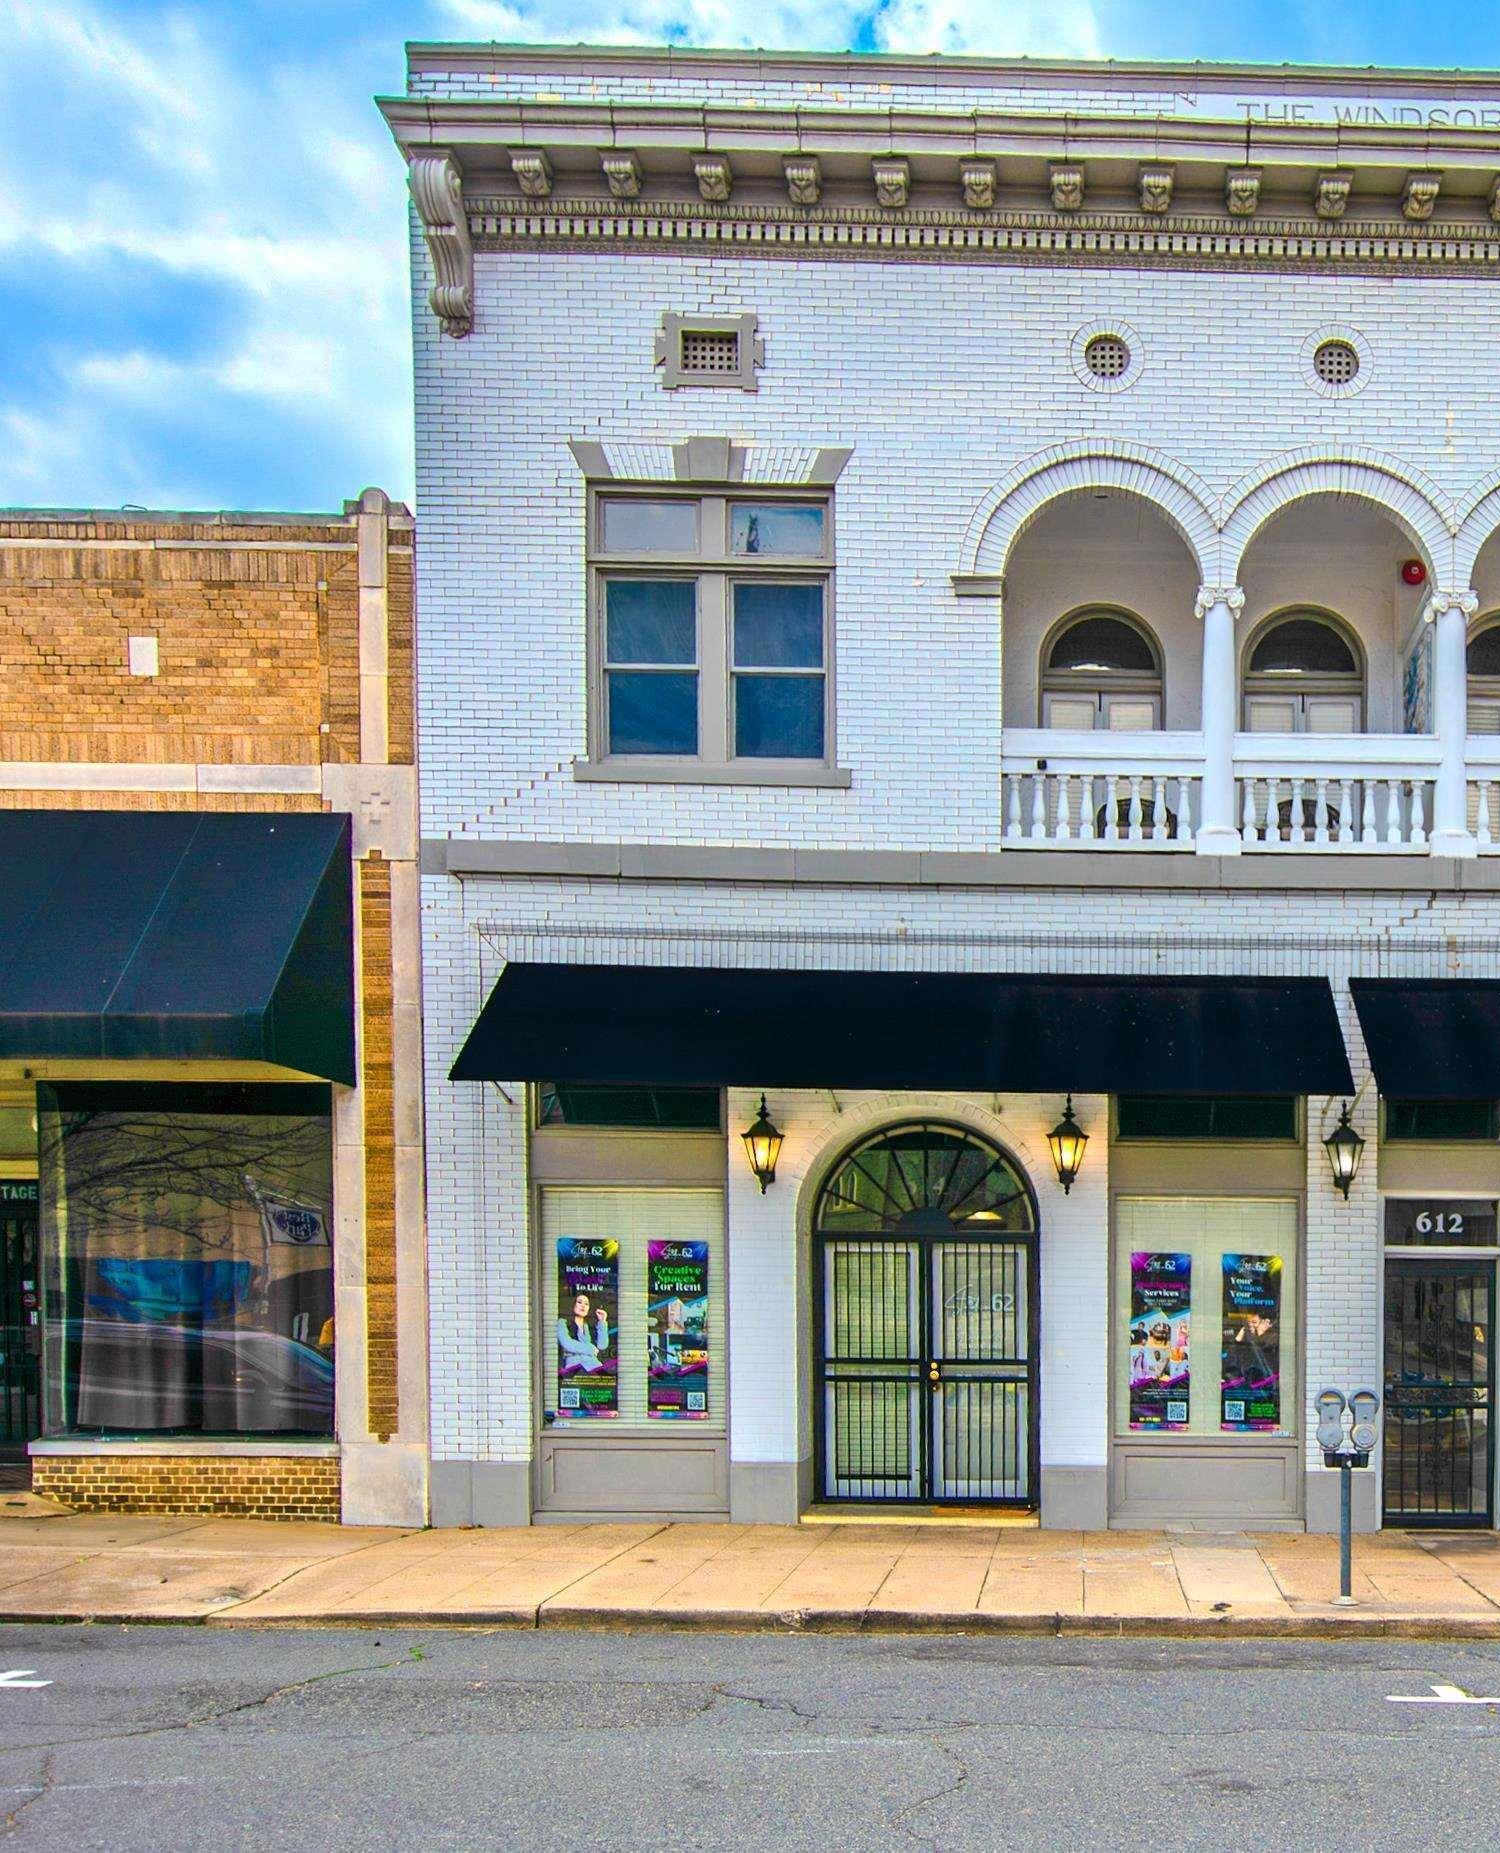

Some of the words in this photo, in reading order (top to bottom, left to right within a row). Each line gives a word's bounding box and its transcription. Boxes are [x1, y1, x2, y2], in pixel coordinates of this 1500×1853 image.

[1236, 103, 1314, 123] THE
[1416, 1211, 1464, 1233] 612
[589, 1265, 611, 1273] Your
[1164, 1260, 1176, 1270] 62
[992, 1293, 1015, 1313] 62
